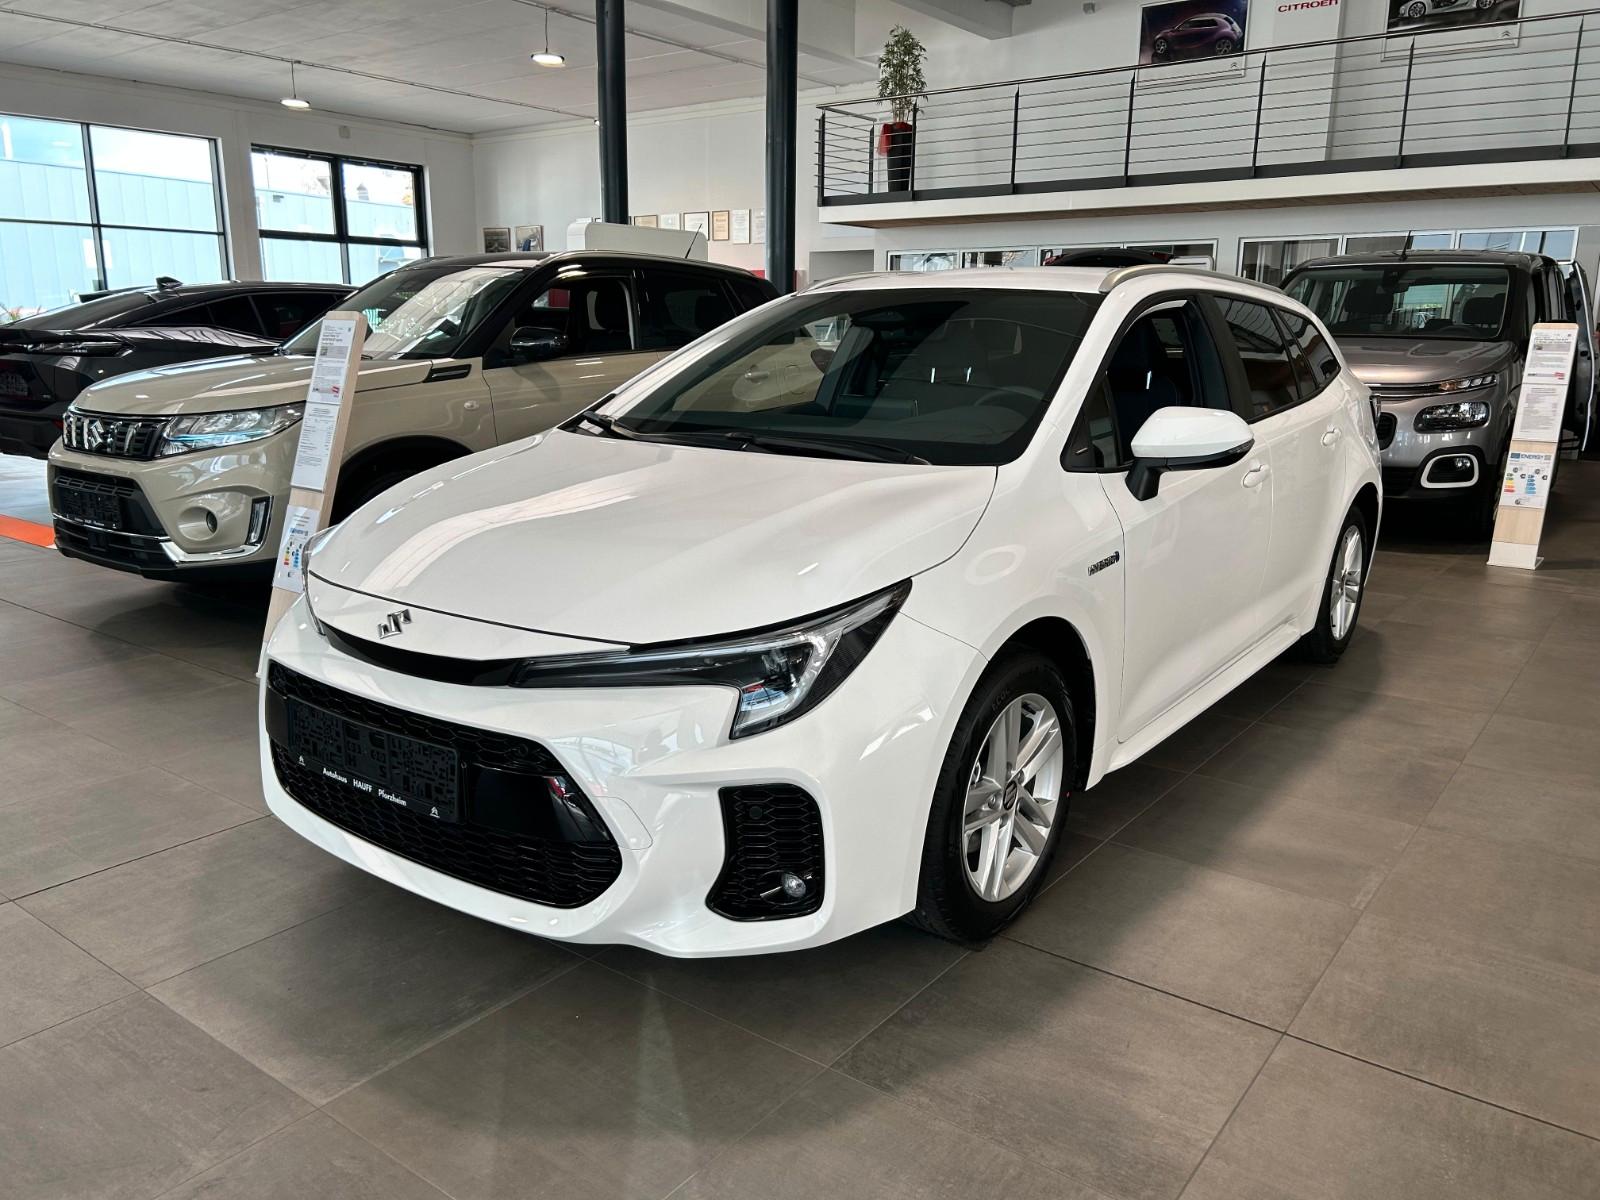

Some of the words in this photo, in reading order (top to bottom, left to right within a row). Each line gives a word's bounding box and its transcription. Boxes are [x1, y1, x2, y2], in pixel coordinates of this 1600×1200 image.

[322, 767, 348, 784] Autohaus
[353, 778, 373, 793] HAUFF
[378, 788, 407, 807] Pforzheim
